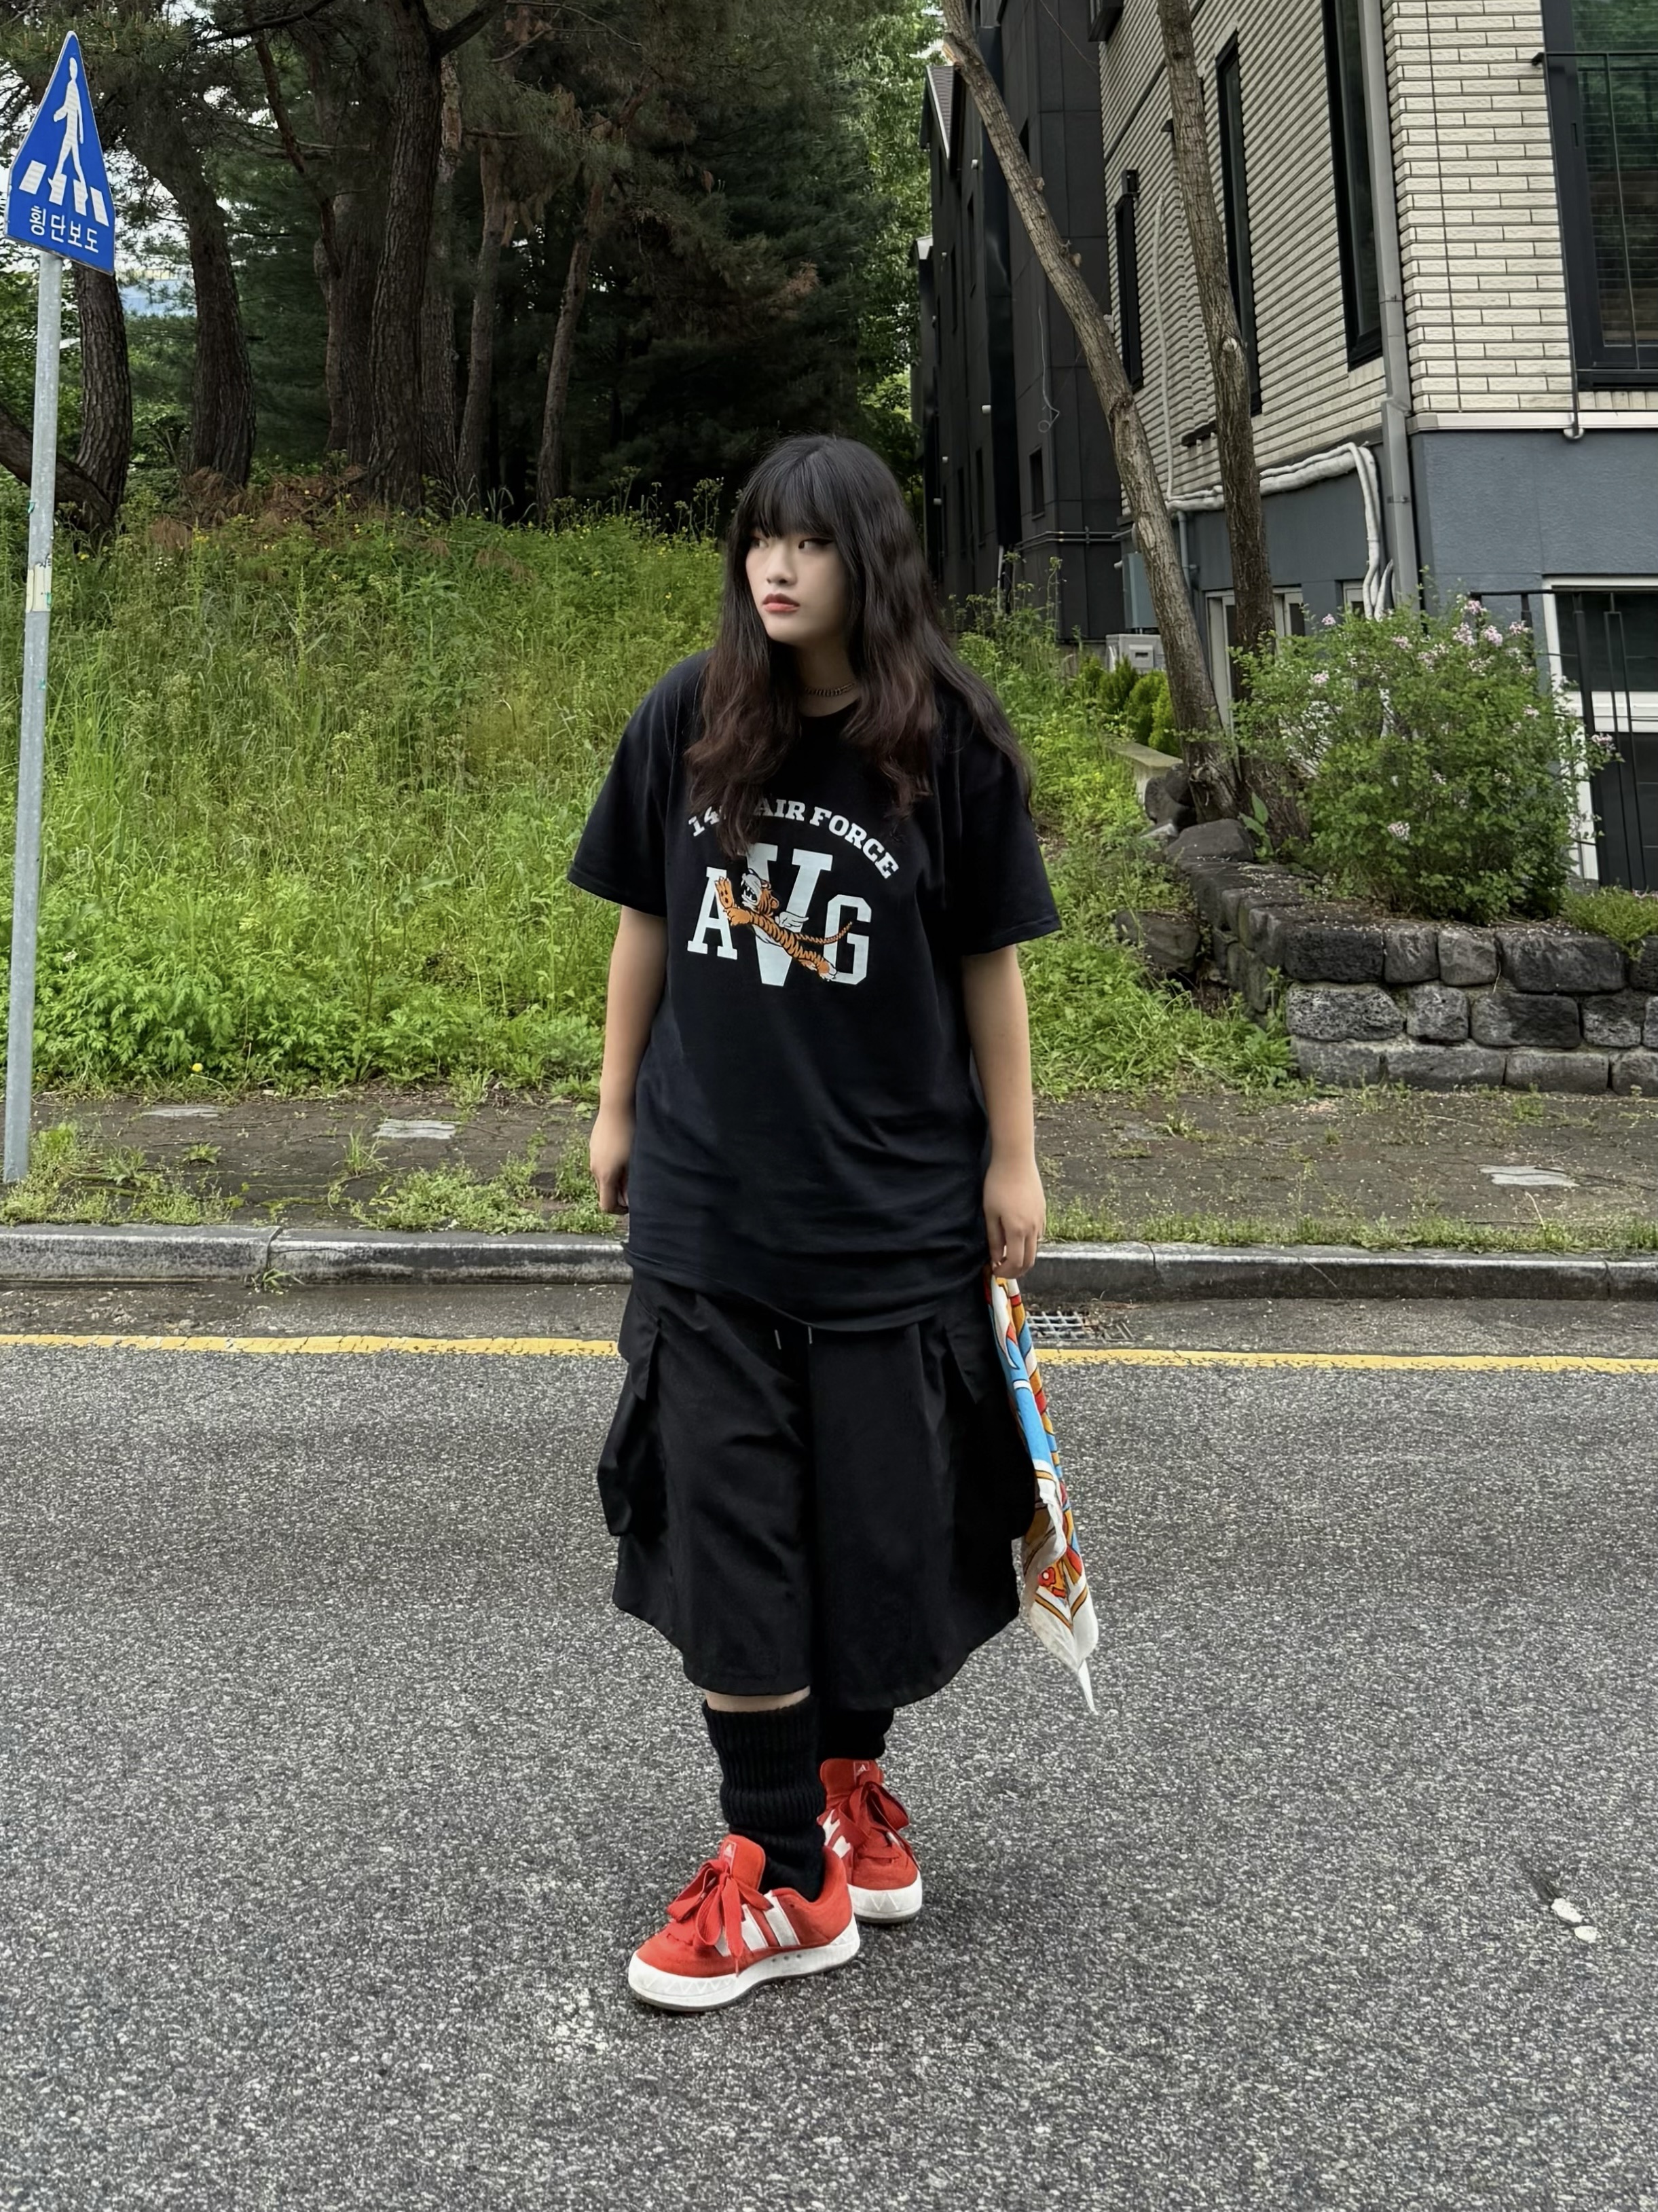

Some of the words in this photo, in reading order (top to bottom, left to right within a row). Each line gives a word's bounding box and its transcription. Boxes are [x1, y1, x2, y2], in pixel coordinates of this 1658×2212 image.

[29, 205, 99, 253] 횡단보도
[754, 797, 805, 822] AIR
[809, 805, 900, 880] FORCE
[687, 841, 872, 987] AVG
